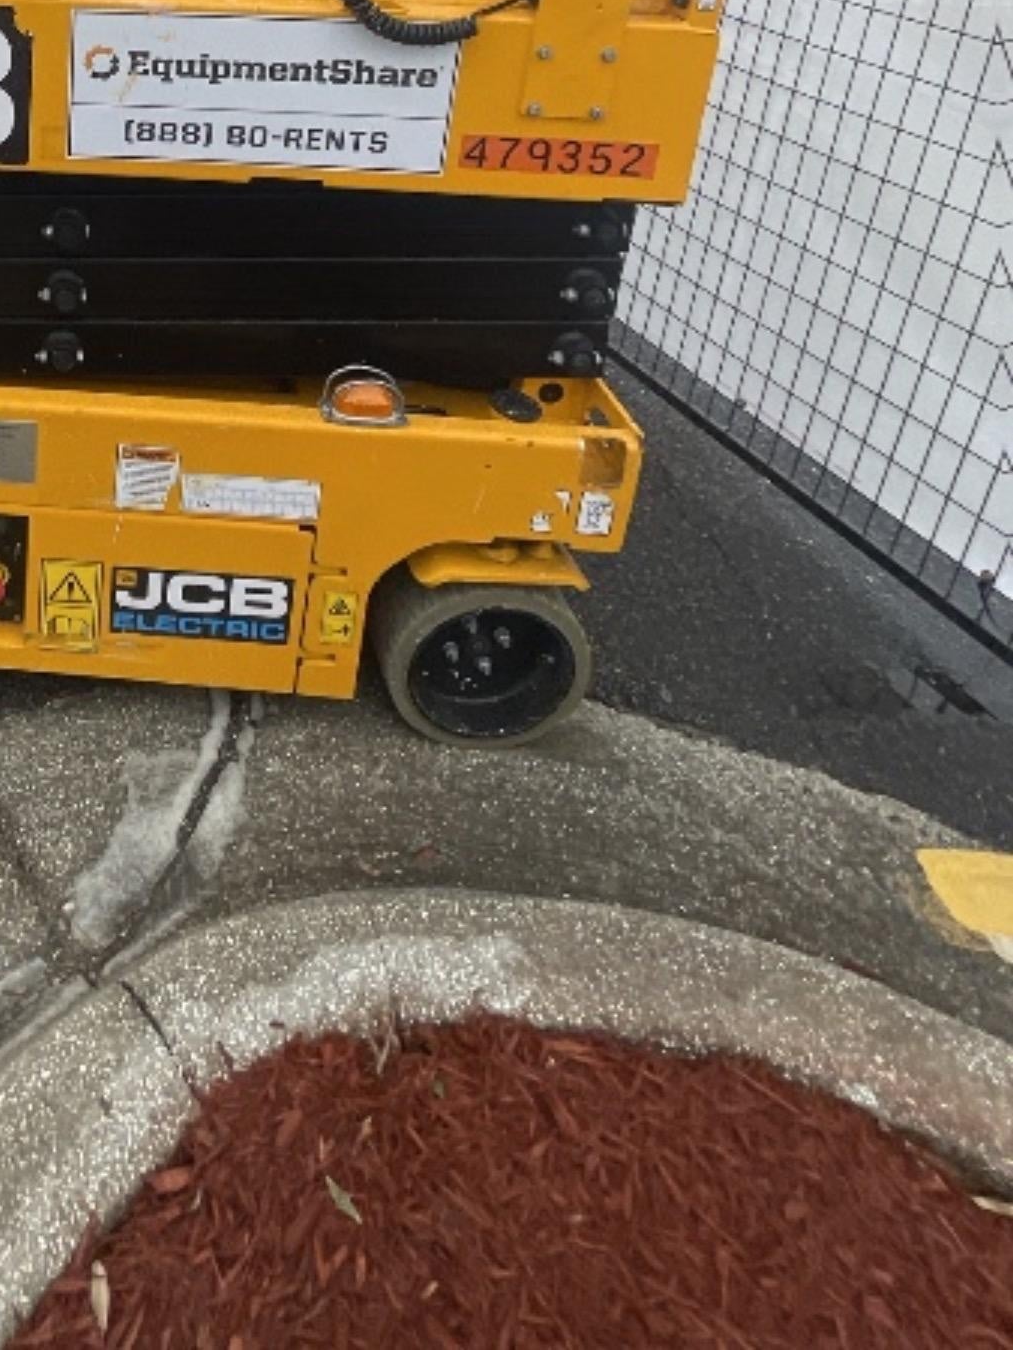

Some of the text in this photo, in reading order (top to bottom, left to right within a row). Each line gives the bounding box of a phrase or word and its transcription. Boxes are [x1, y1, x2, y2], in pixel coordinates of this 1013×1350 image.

[127, 50, 438, 89] EquipmentShare
[124, 118, 213, 148] (888)
[463, 136, 646, 176] 479352
[115, 572, 289, 619] JCB
[112, 610, 287, 641] ELECTRIC
